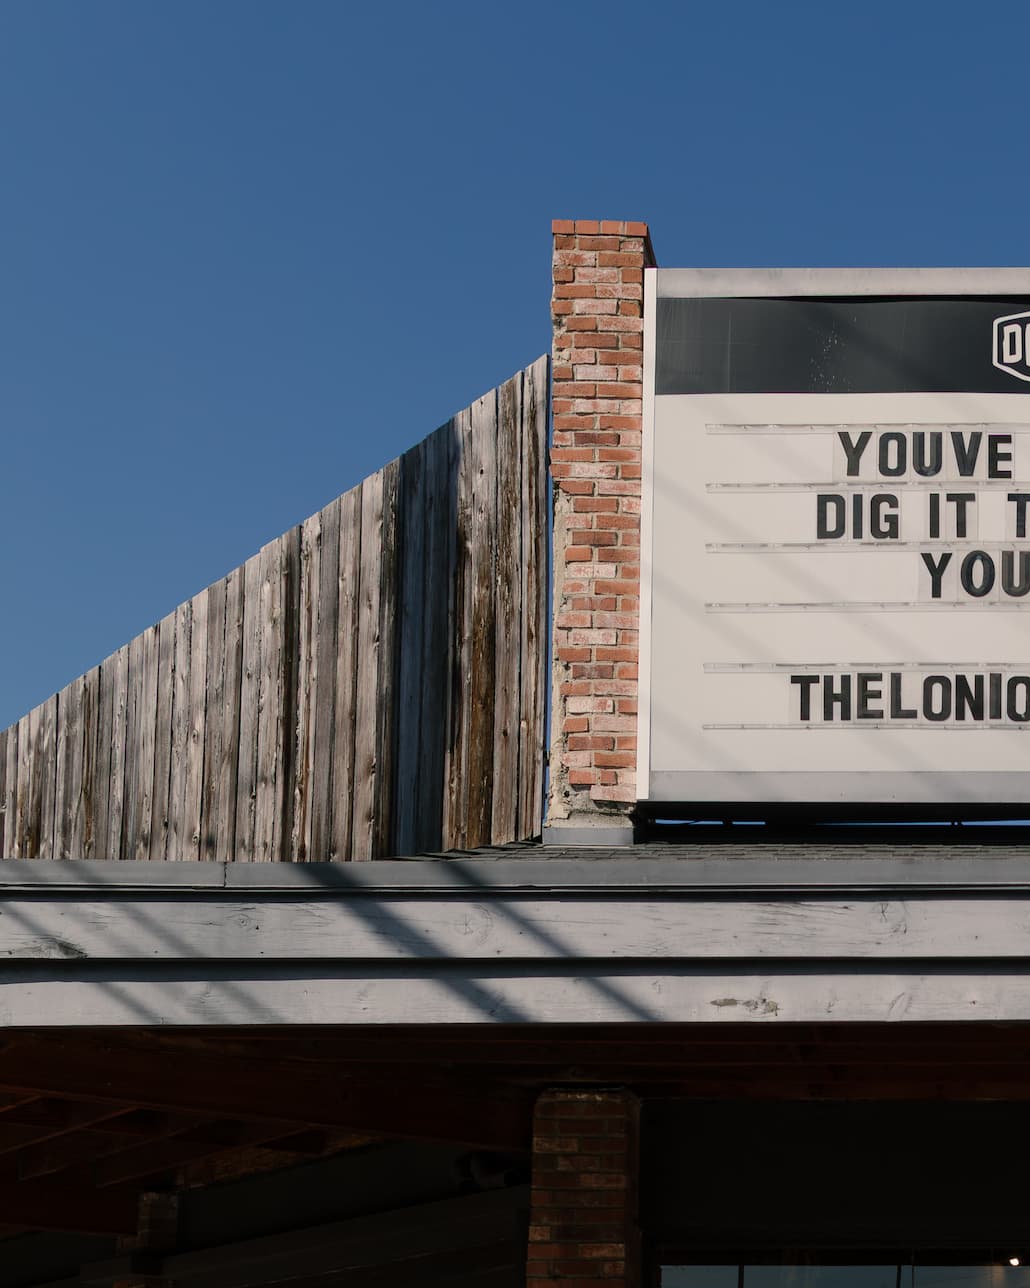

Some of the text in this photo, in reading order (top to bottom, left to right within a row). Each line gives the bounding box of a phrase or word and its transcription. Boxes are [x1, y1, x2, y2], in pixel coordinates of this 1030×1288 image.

[838, 432, 1012, 479] YOUVE
[817, 494, 898, 539] DIG
[930, 493, 975, 538] IT
[921, 550, 1030, 598] YOU
